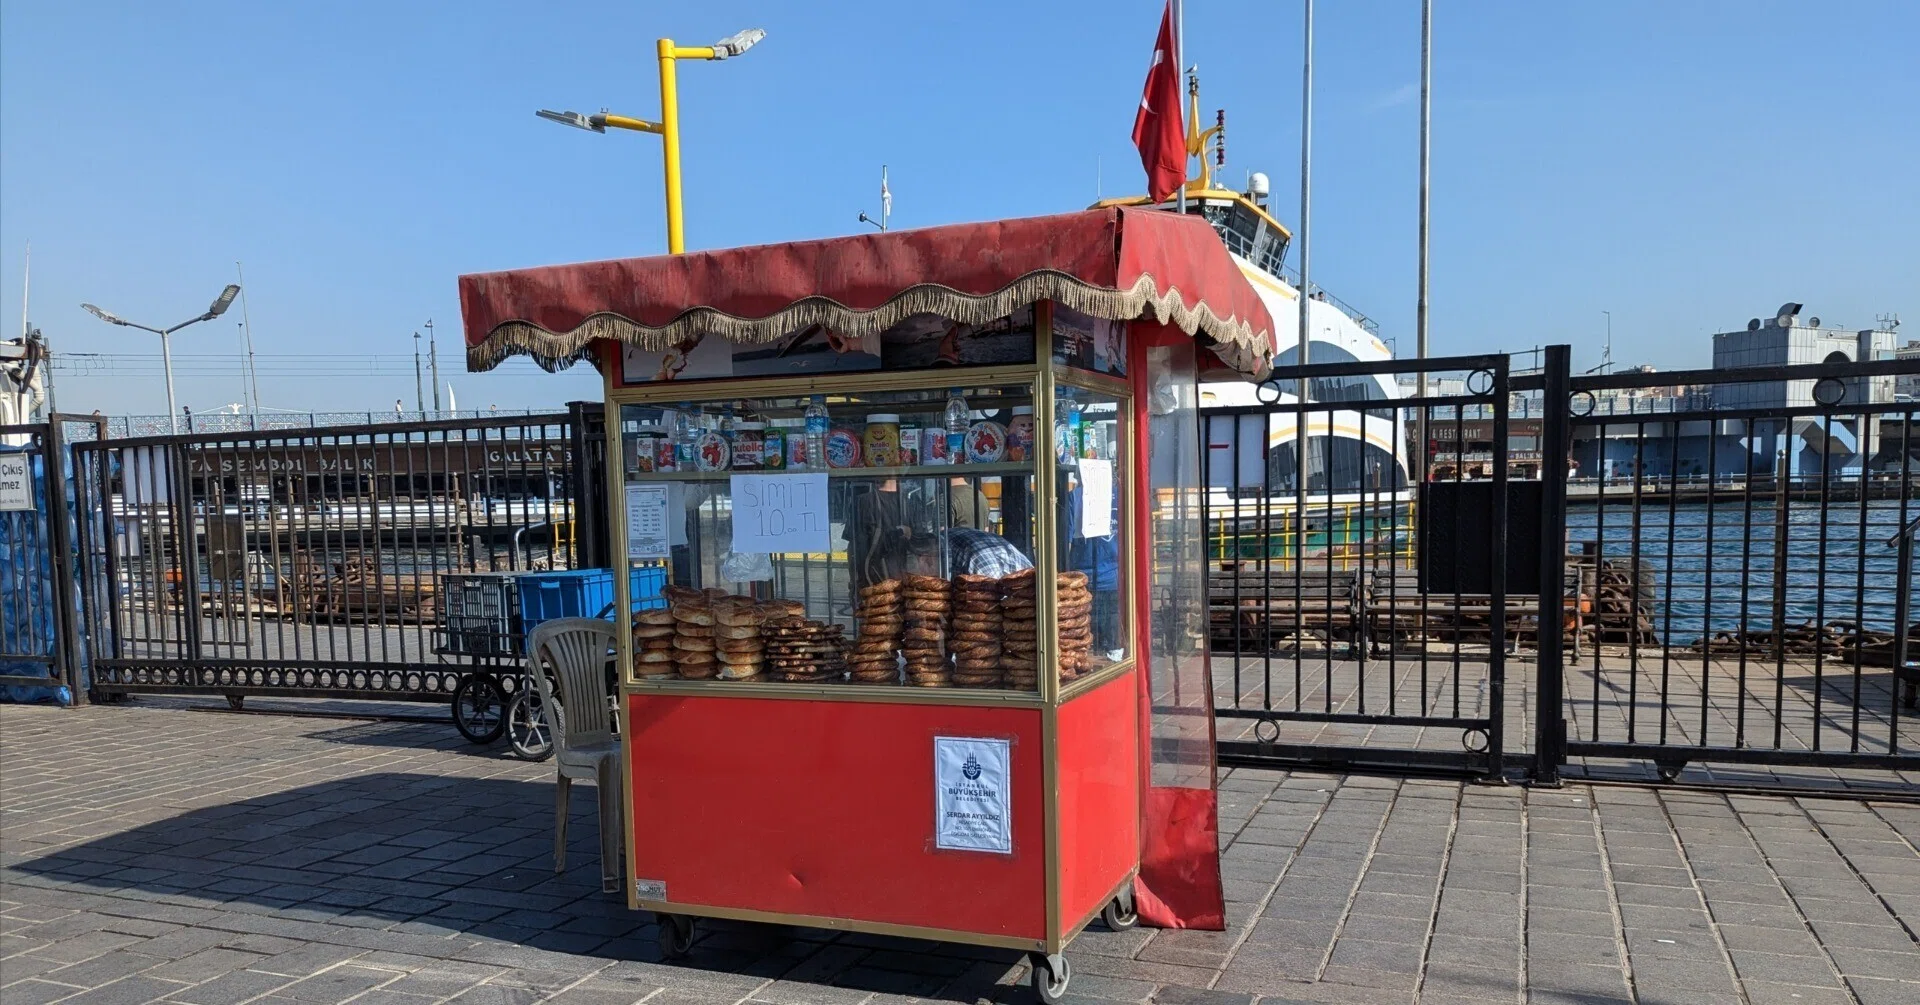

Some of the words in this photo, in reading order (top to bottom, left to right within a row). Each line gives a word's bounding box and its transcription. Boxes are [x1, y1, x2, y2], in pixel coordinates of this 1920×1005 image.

[1439, 428, 1481, 438] RESTRANT
[733, 441, 764, 453] nutella
[489, 451, 554, 462] GALATA
[2, 464, 23, 476] Çıkış
[316, 458, 372, 471] BALK
[0, 480, 20, 490] mez
[797, 511, 827, 532] TL
[948, 788, 996, 797] BÜYÜKŞEHİR
